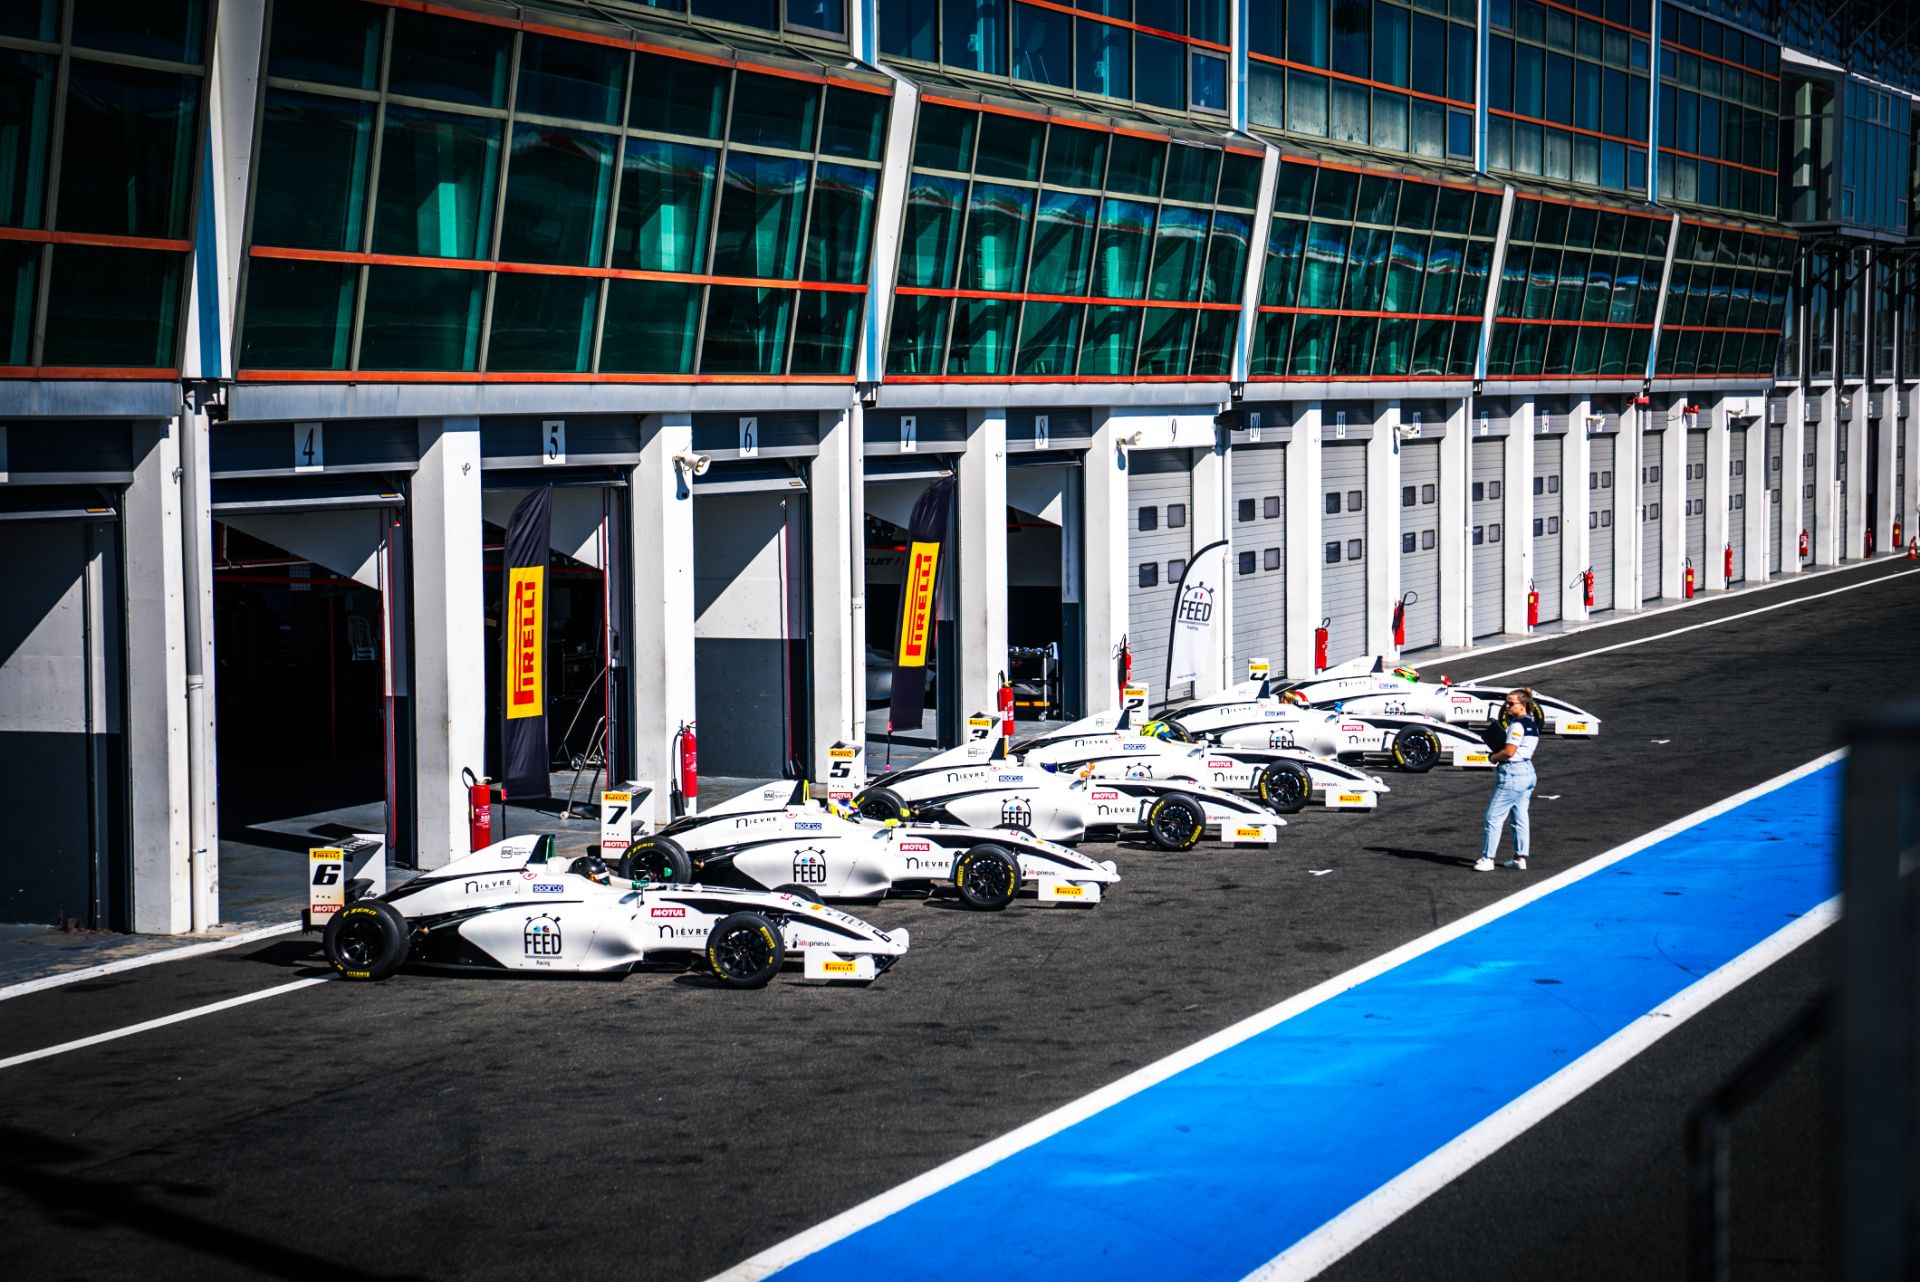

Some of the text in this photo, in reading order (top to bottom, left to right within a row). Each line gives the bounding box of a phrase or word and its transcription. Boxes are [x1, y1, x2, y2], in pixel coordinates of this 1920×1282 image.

[744, 421, 753, 453] 6
[905, 419, 912, 447] 7
[1038, 418, 1045, 446] 8
[1171, 418, 1177, 443] 9
[1251, 416, 1260, 439] 10
[302, 427, 315, 467] 4
[550, 426, 559, 460] 5
[905, 553, 933, 656] PIRELLI
[1178, 600, 1212, 623] FEED
[513, 580, 536, 705] PIRELLI
[830, 761, 852, 778] 5
[607, 806, 628, 824] 7
[312, 864, 341, 885] 6
[793, 864, 826, 882] FEED
[652, 908, 685, 917] MOTUL
[524, 932, 562, 954] FEED
[798, 939, 830, 947] allopneus
